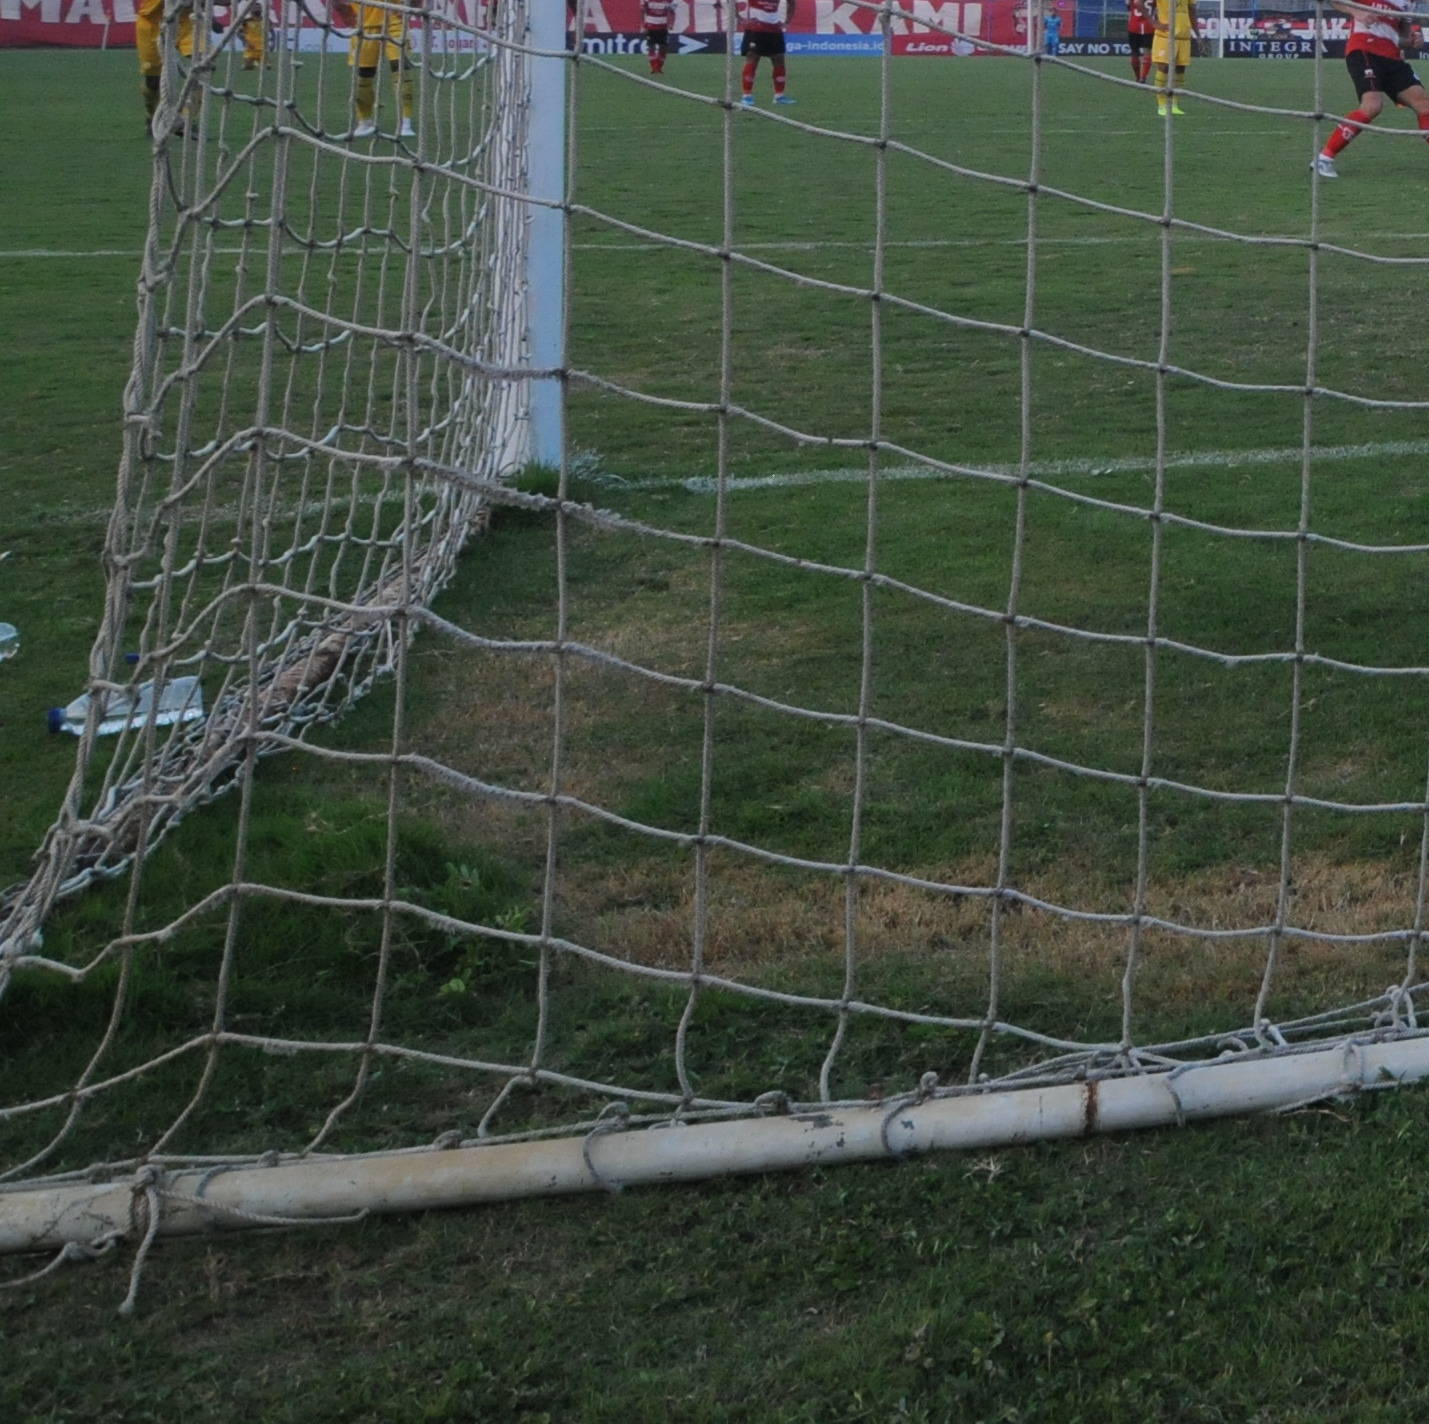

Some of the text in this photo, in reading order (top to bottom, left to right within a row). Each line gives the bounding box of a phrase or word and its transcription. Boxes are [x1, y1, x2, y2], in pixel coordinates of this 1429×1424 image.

[815, 0, 982, 36] KAMI
[1058, 43, 1085, 55] SAY
[1087, 43, 1112, 55] NO
